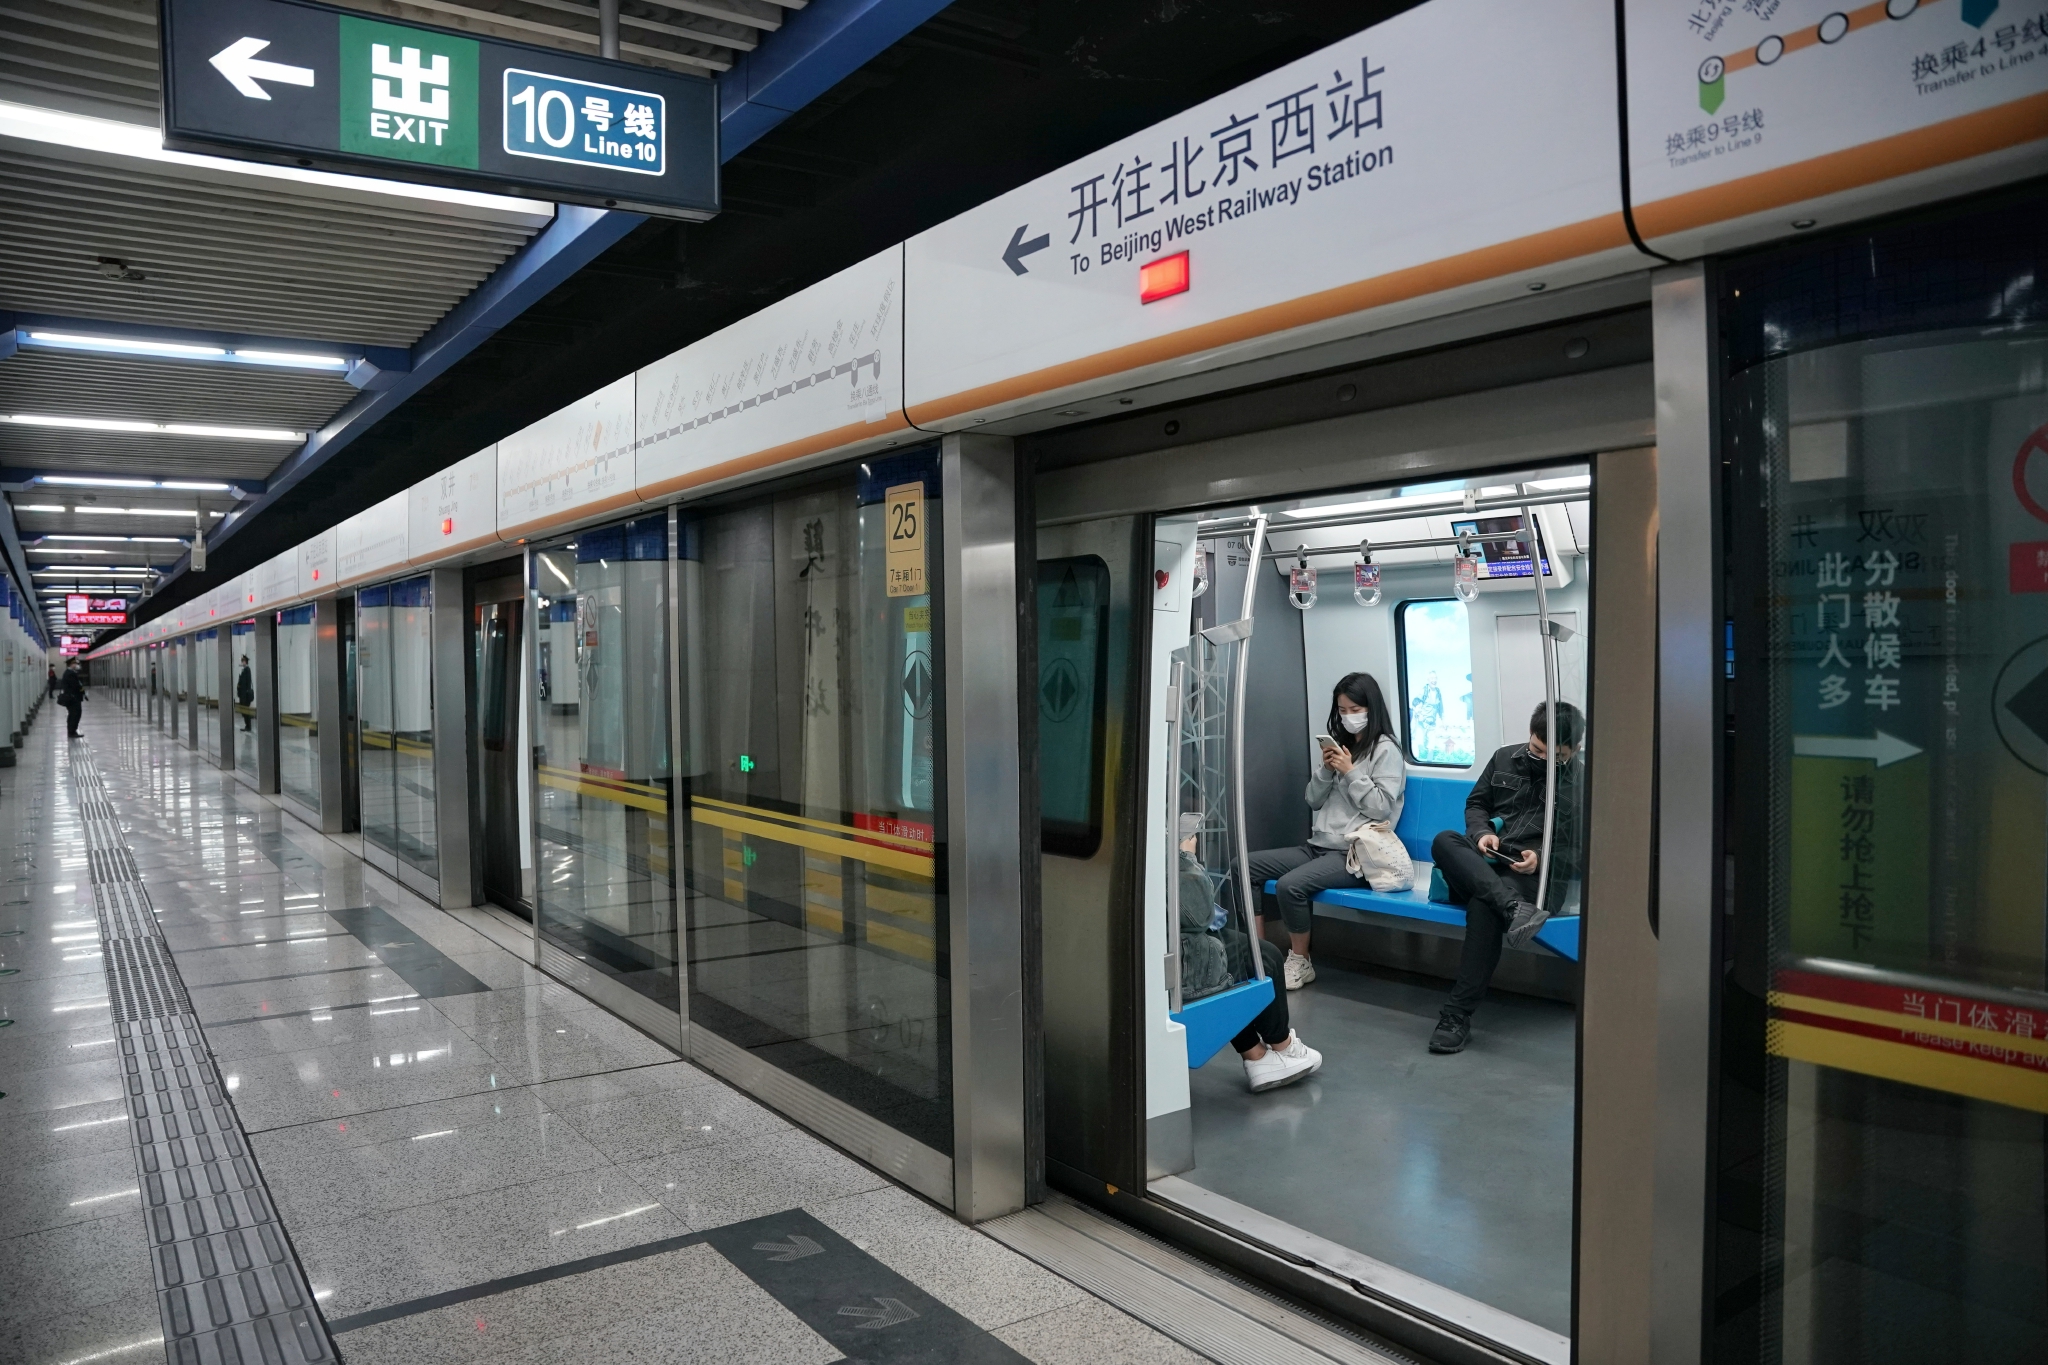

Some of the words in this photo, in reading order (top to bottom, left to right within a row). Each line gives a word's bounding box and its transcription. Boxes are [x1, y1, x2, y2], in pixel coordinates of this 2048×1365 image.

[371, 43, 450, 121] 出
[1915, 67, 1977, 96] Transfer
[1979, 63, 1995, 76] to
[1999, 50, 2035, 71] Line
[370, 111, 450, 147] EXIT
[1067, 56, 1386, 245] 开往北京西站
[1665, 107, 1765, 157] 换乘9号线
[1668, 149, 1713, 168] Transfer
[1714, 145, 1725, 156] to
[1727, 137, 1752, 152] Line
[1753, 132, 1763, 145] 9
[1070, 254, 1090, 276] To
[1099, 229, 1162, 266] Beijing
[1165, 206, 1215, 242] West
[1217, 178, 1303, 224] Railway
[1306, 145, 1394, 193] Station
[892, 501, 917, 541] 25
[1944, 569, 1959, 606] door
[1816, 551, 1852, 710] 此门人多
[1863, 549, 1901, 711] 分散候车
[1839, 774, 1876, 951] 请勿抢上抢下
[1969, 1042, 2018, 1065] keep
